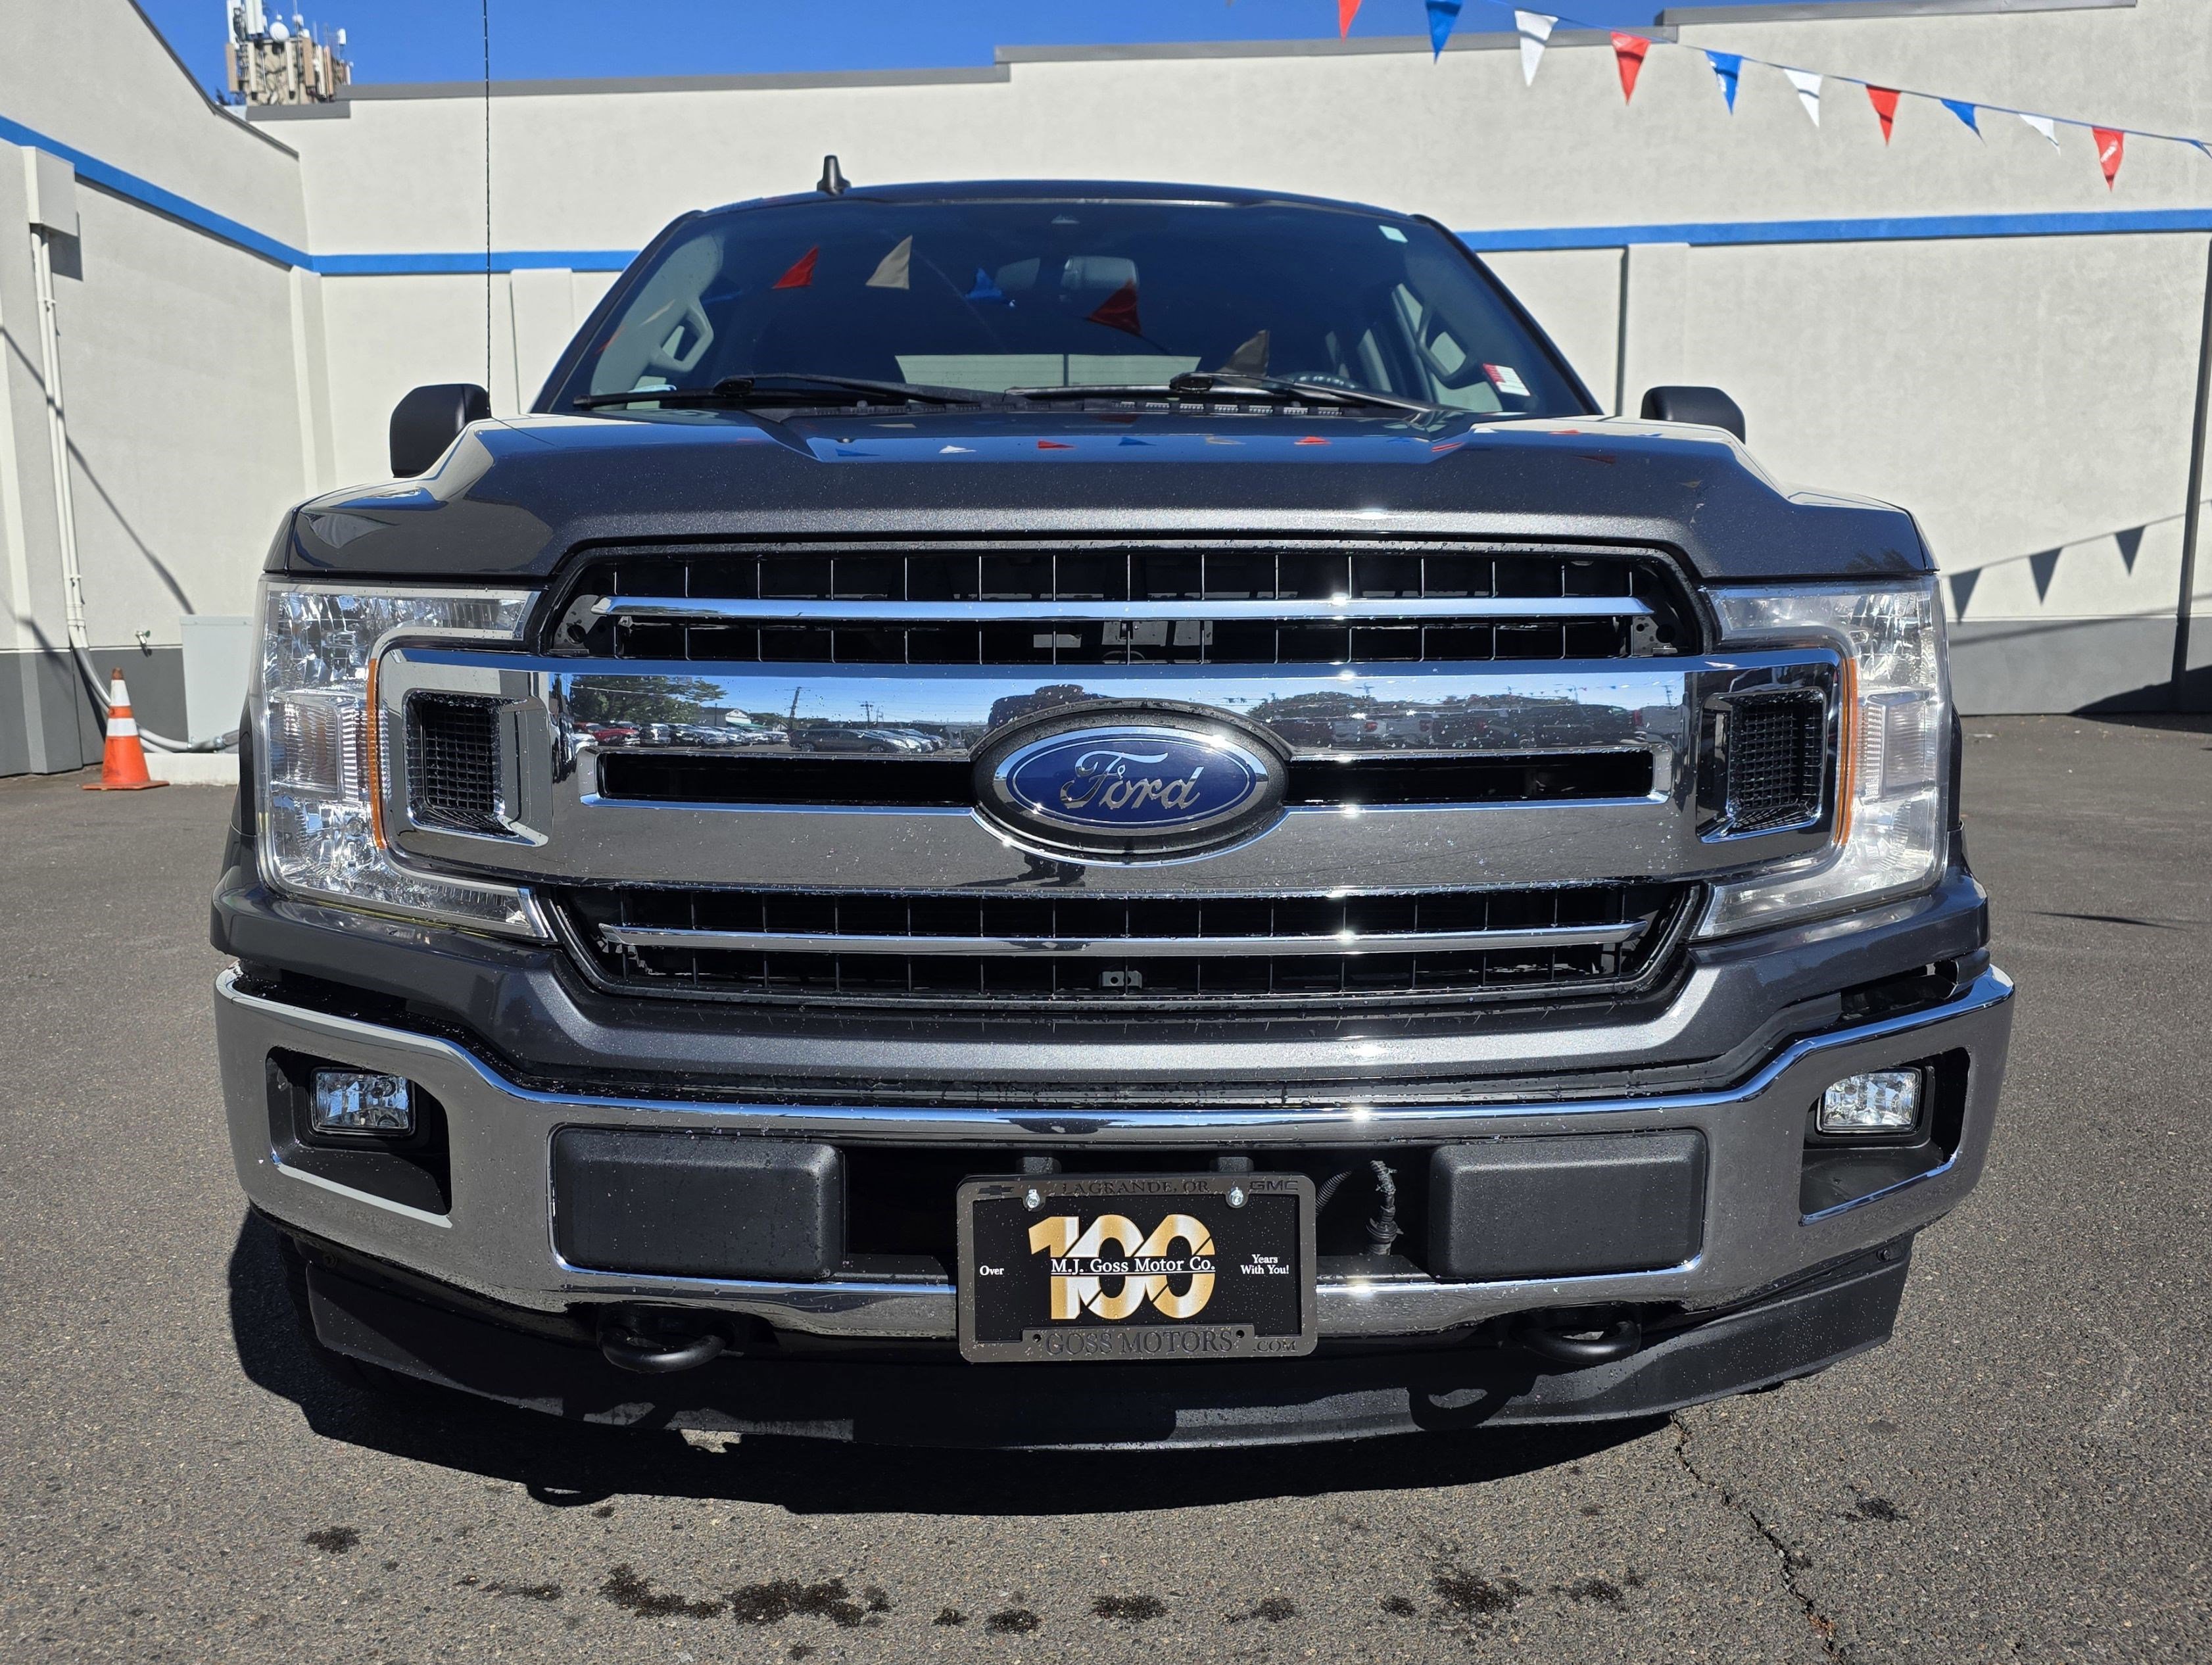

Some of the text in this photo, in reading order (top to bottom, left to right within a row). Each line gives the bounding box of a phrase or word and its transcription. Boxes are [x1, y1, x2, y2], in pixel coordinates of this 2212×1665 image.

[1059, 750, 1205, 809] Ford
[1184, 1180, 1211, 1193] OR
[1250, 1180, 1299, 1191] GMC
[1251, 1253, 1278, 1264] Years
[979, 1265, 1005, 1276] Over
[1028, 1214, 1215, 1319] 100
[1051, 1256, 1216, 1275] M.J. Goss Motor Co.
[1240, 1264, 1289, 1274] With You!
[1046, 1330, 1233, 1355] GOSS MOTORS
[1253, 1339, 1297, 1353] .COM
